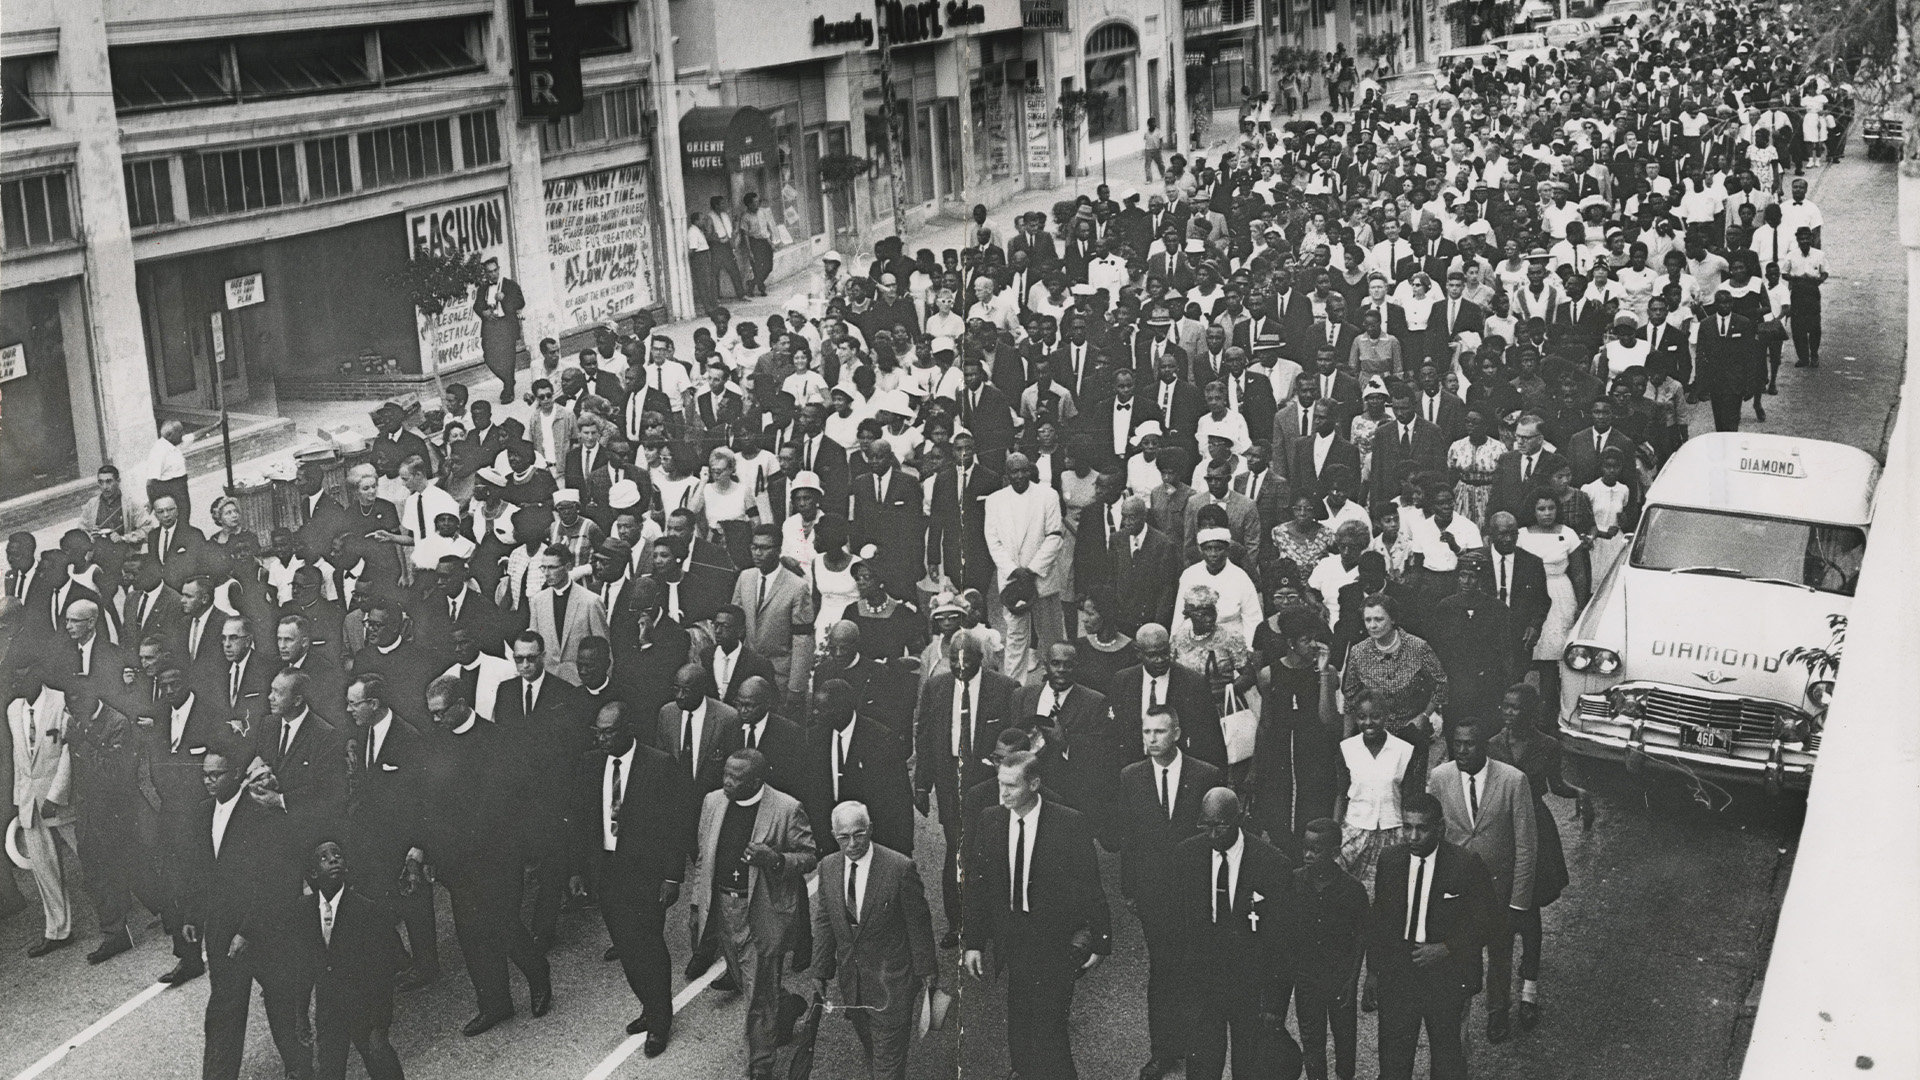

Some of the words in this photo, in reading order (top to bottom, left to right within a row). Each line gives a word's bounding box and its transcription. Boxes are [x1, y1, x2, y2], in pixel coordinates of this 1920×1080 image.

[1023, 10, 1063, 28] LAUNDRY
[692, 156, 723, 168] HOTEL
[740, 151, 764, 168] HOTEL
[583, 170, 617, 191] NOW!
[545, 202, 564, 215] FOR
[567, 199, 584, 213] THE
[586, 193, 611, 209] FIRST
[412, 199, 503, 258] FASHION
[565, 254, 580, 287] AT
[587, 244, 617, 269] LOW!
[1740, 458, 1795, 476] DIAMOND
[1652, 640, 1780, 673] DIAMOND
[1696, 732, 1715, 747] 460
